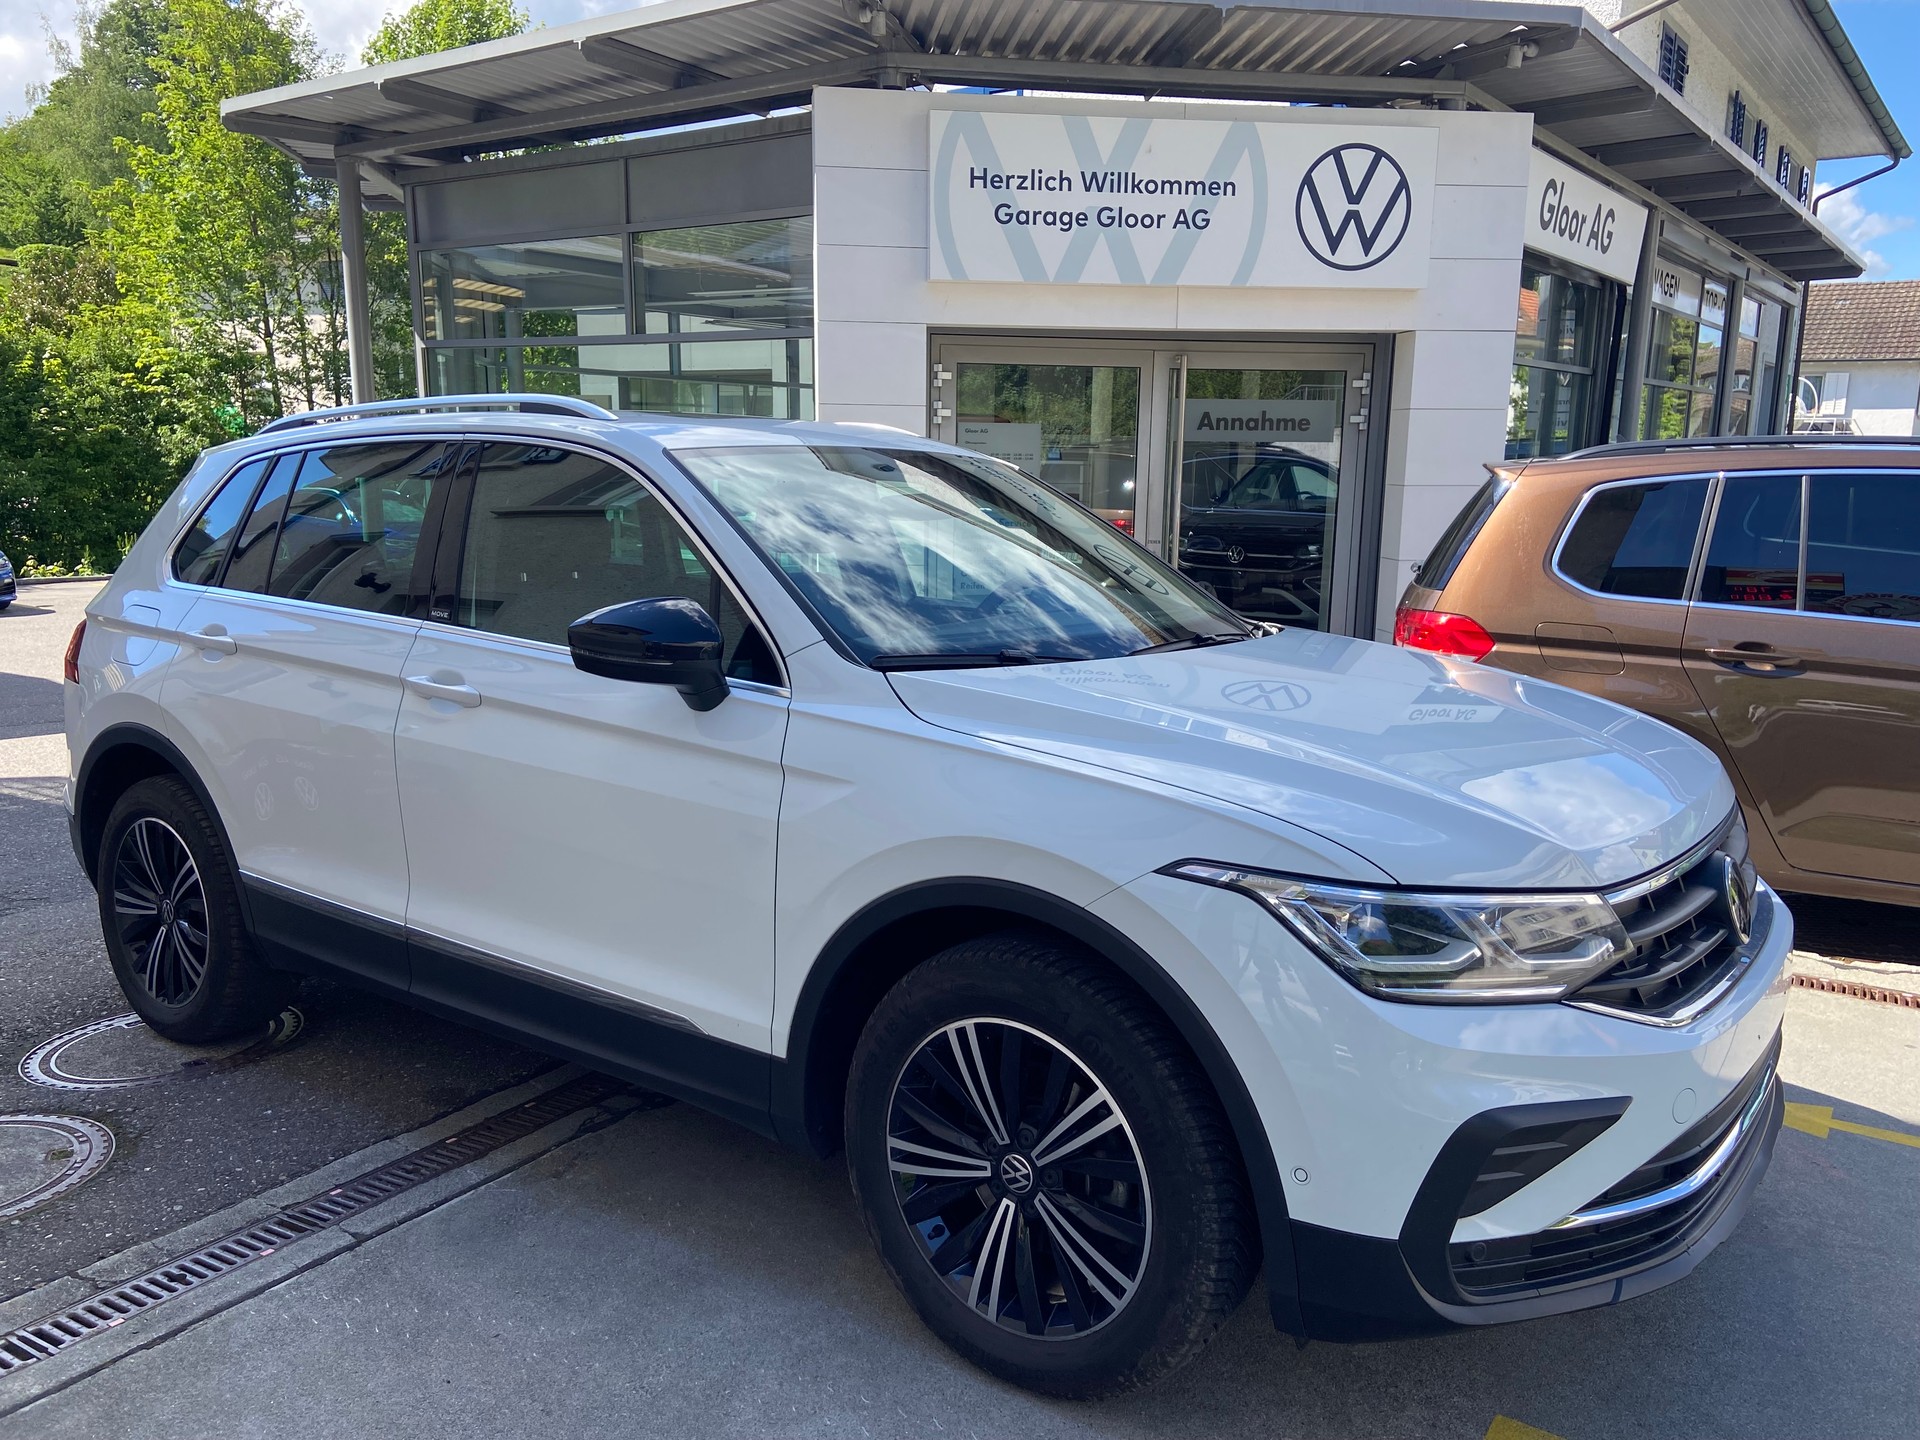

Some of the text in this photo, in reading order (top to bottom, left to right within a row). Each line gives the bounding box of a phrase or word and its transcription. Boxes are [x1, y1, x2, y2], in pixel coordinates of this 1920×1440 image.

[969, 167, 1237, 197] Herzlich Willkommen
[994, 202, 1211, 232] Garage Gloor AG
[1540, 177, 1616, 255] Gloor AG
[1197, 410, 1311, 432] Annahme
[431, 610, 448, 618] MOVE
